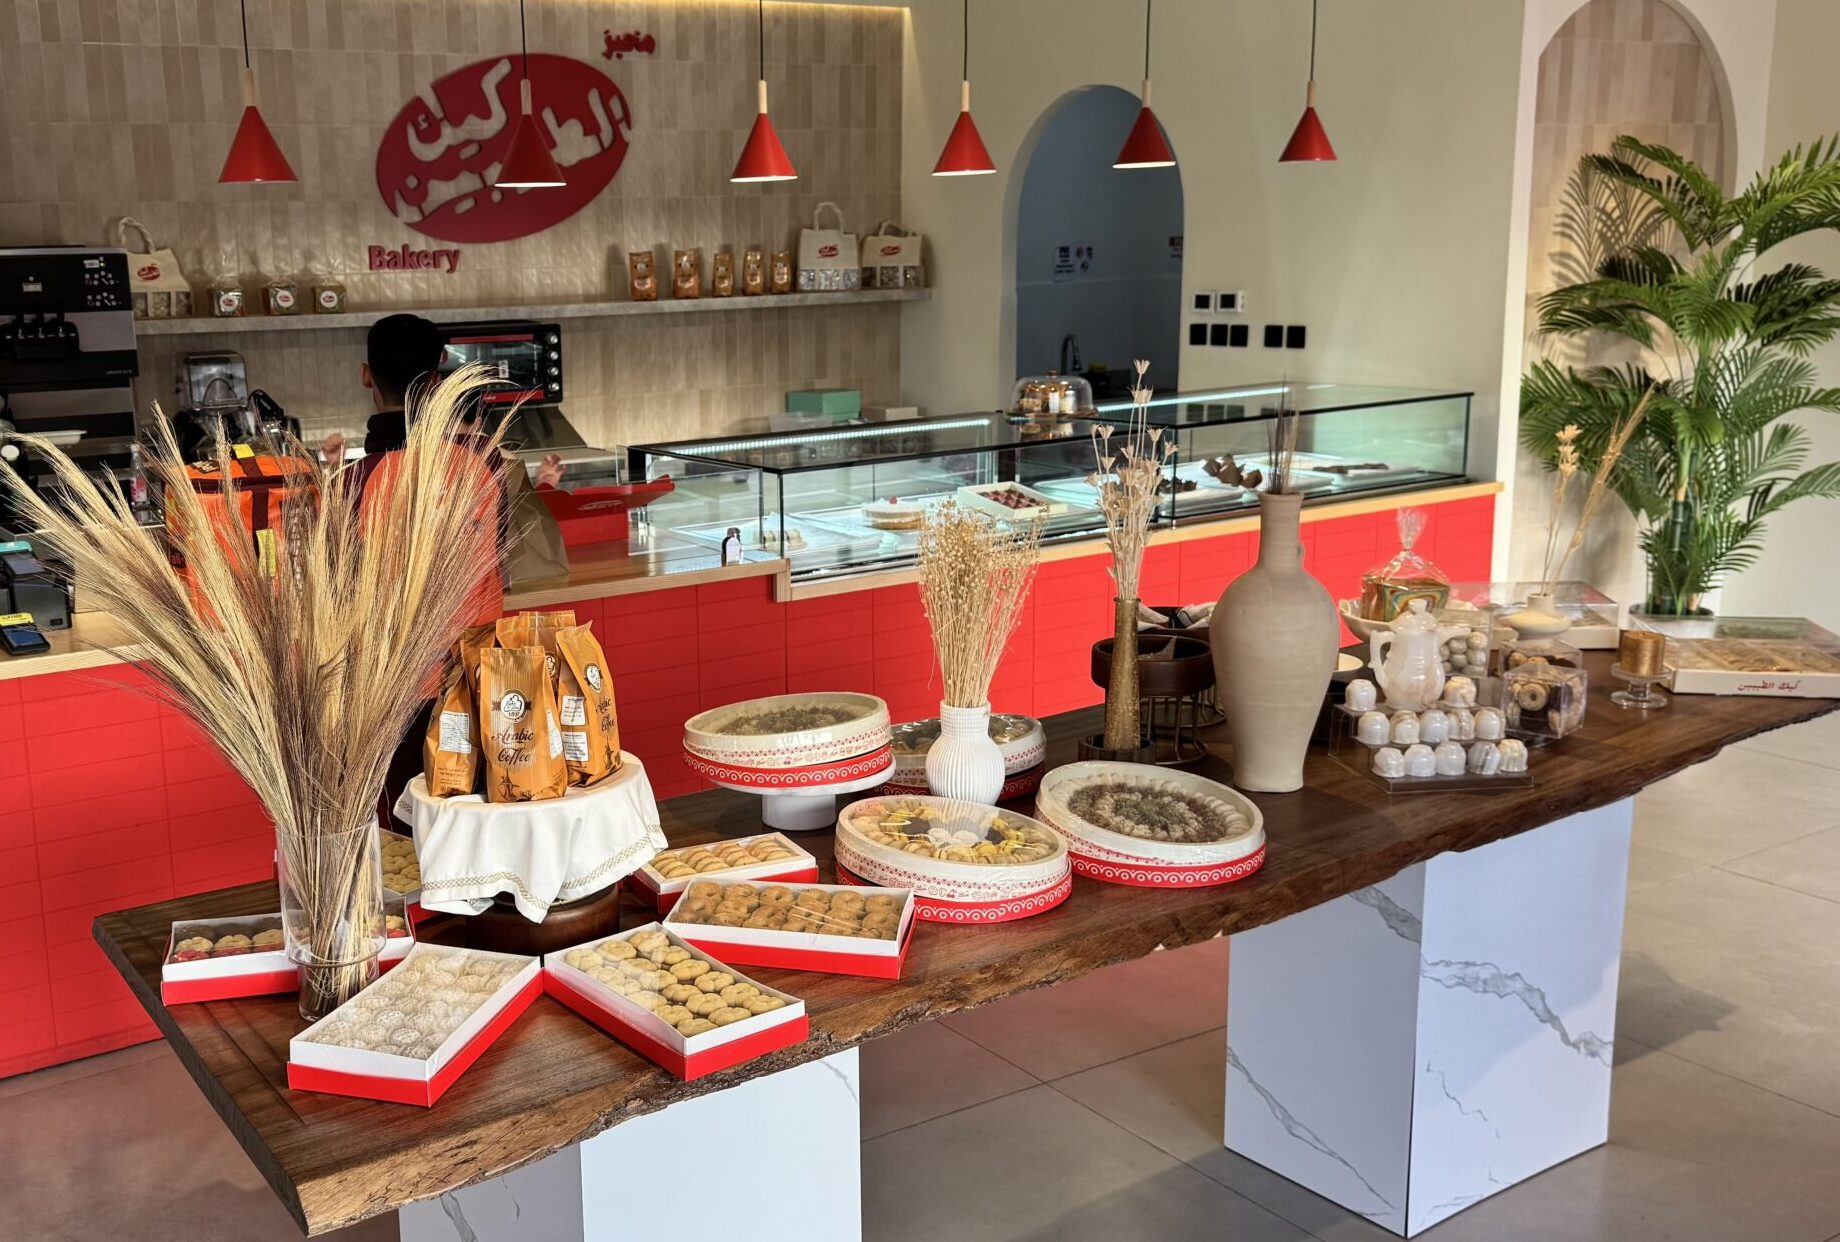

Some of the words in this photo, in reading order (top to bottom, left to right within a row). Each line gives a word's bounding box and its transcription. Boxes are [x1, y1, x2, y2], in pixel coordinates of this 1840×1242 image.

[602, 29, 656, 60] مخبز
[368, 244, 460, 274] Bakery
[491, 727, 535, 744] Arabic
[497, 747, 532, 766] Coffee
